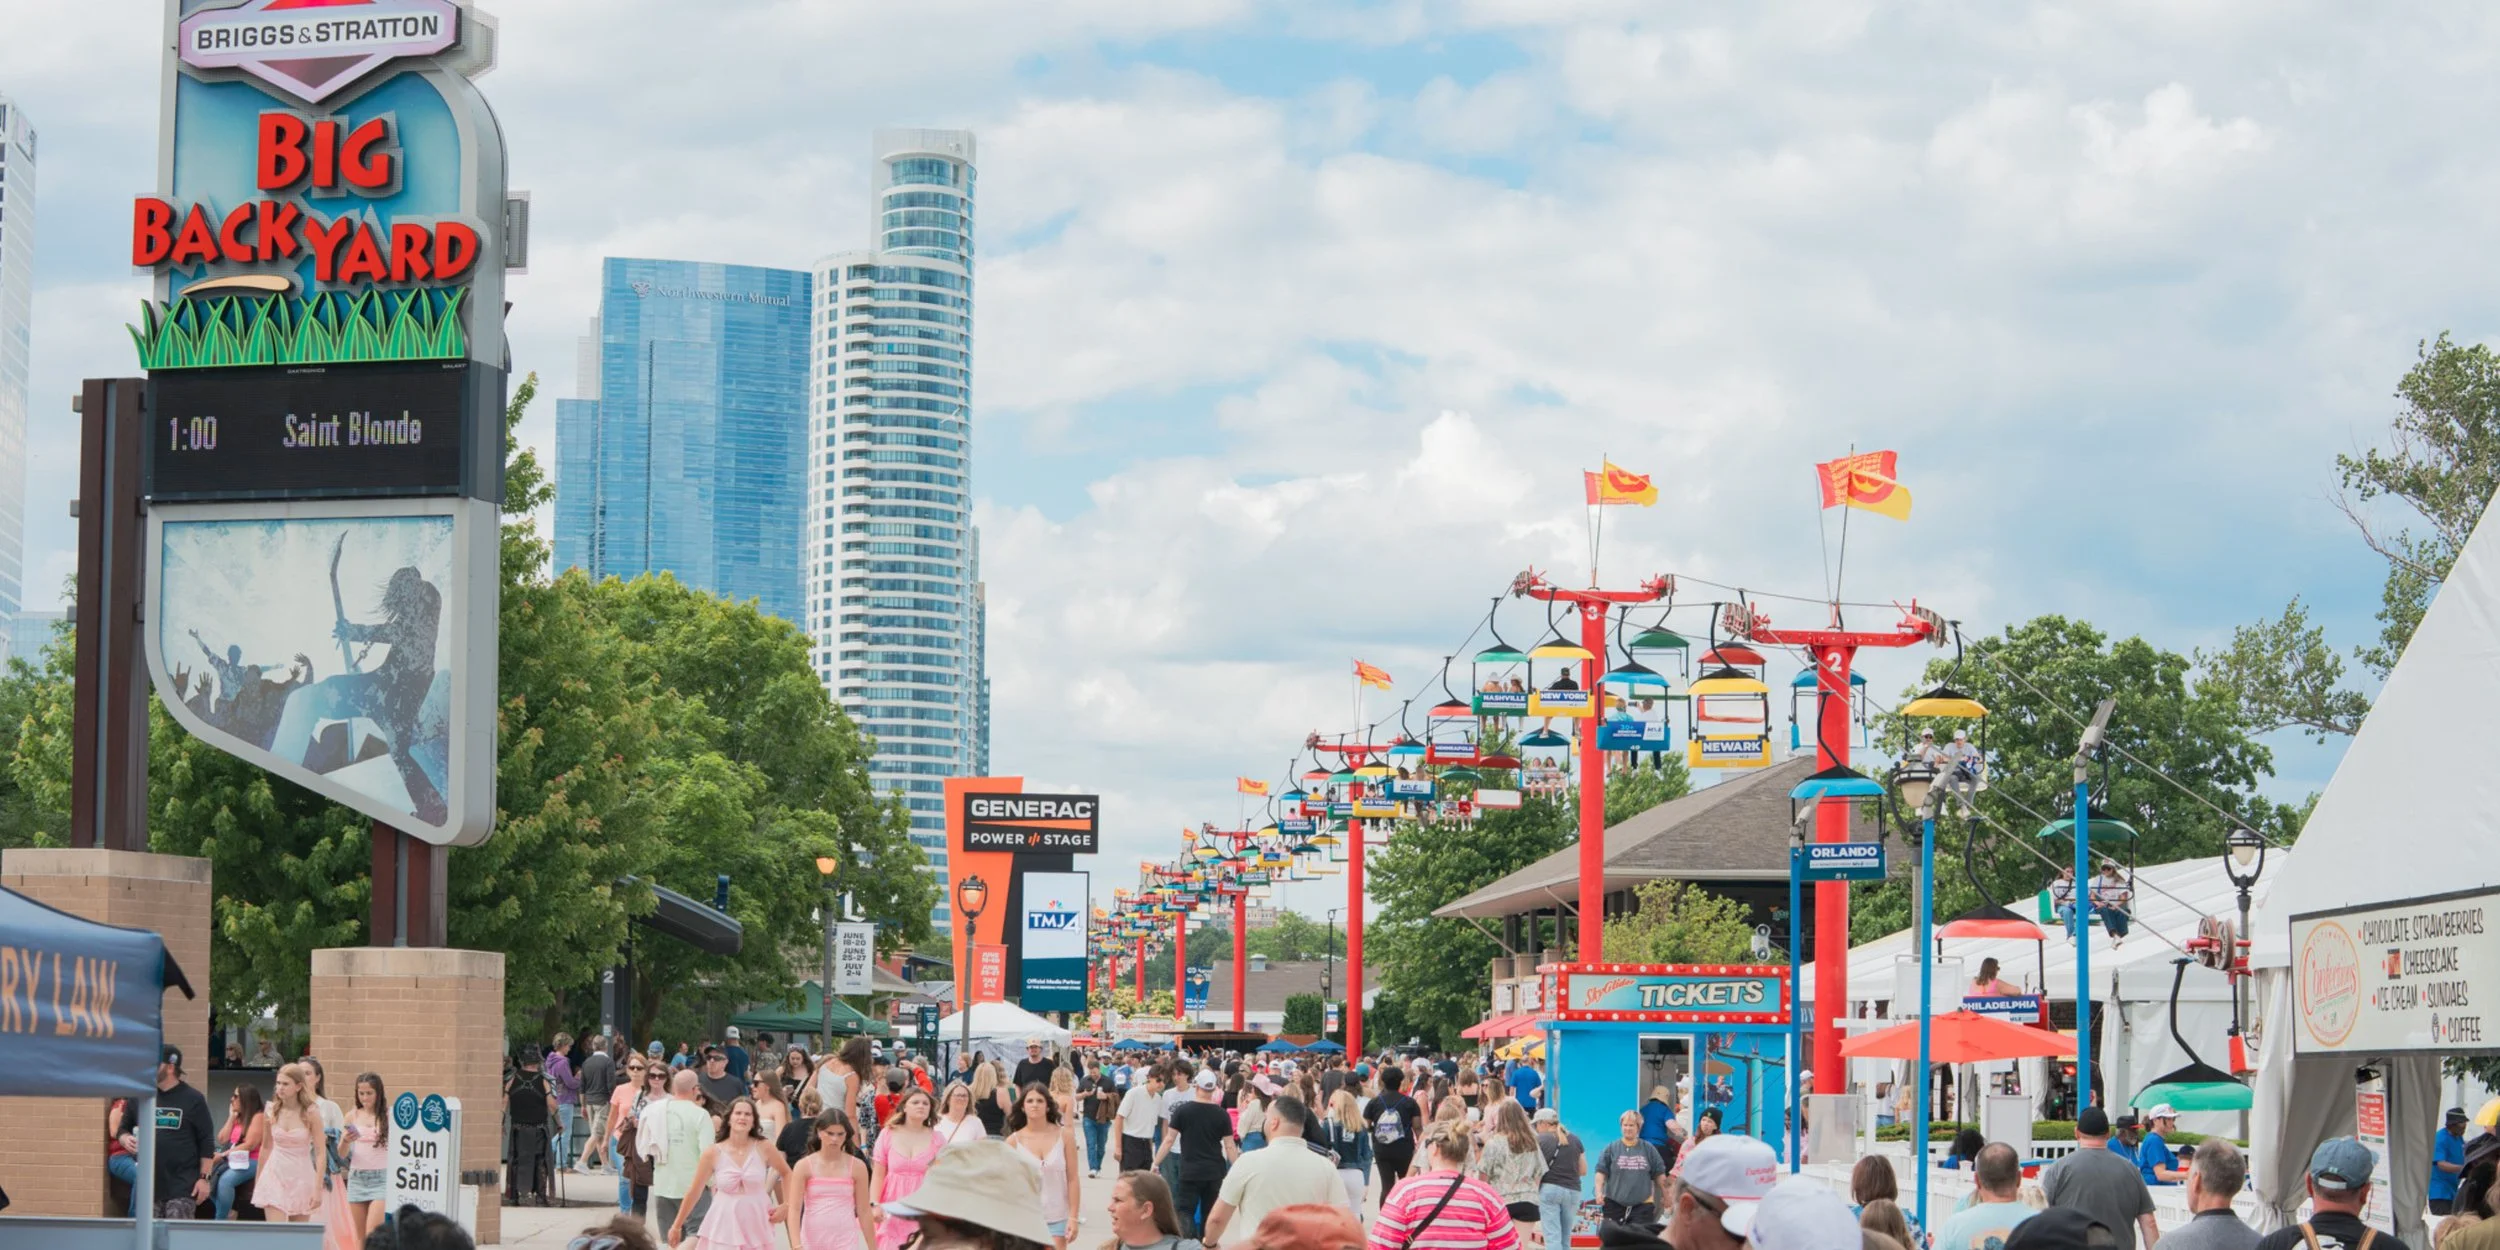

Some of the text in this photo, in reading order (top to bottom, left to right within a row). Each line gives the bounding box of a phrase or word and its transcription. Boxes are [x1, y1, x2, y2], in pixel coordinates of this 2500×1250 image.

[198, 16, 438, 49] BRIGGS & STRATTON
[258, 113, 393, 190] BIG
[132, 197, 479, 285] BACKYARD
[656, 285, 790, 307] Northwestern Mutual
[170, 410, 422, 451] 1:00 Saint Blonde
[1586, 605, 1598, 621] 3
[1827, 652, 1842, 672] 2
[1483, 694, 1526, 702] NASHVILLE
[1540, 692, 1587, 700] NEW YORK
[1703, 741, 1761, 752] NEWARK
[971, 799, 1092, 819] GENERAC
[970, 832, 1092, 846] POWER STAGE
[1811, 846, 1877, 858] ORLANDO
[1029, 911, 1081, 936] TMJ4
[2363, 907, 2484, 946] CHOCOLATE STRAWBERRIES
[2403, 946, 2459, 976] CHEESECAKE
[603, 970, 614, 983] 2
[53, 952, 117, 1038] LAW
[1638, 980, 1765, 1009] TICKETS
[1962, 1000, 2037, 1010] PHILADELPHIA
[2377, 987, 2389, 1011] ICE
[2391, 984, 2418, 1010] CREAM
[2427, 980, 2469, 1008] SUNDAES
[2447, 1016, 2481, 1043] COFFEE
[399, 1134, 437, 1159] Sun
[395, 1166, 439, 1192] Sani
